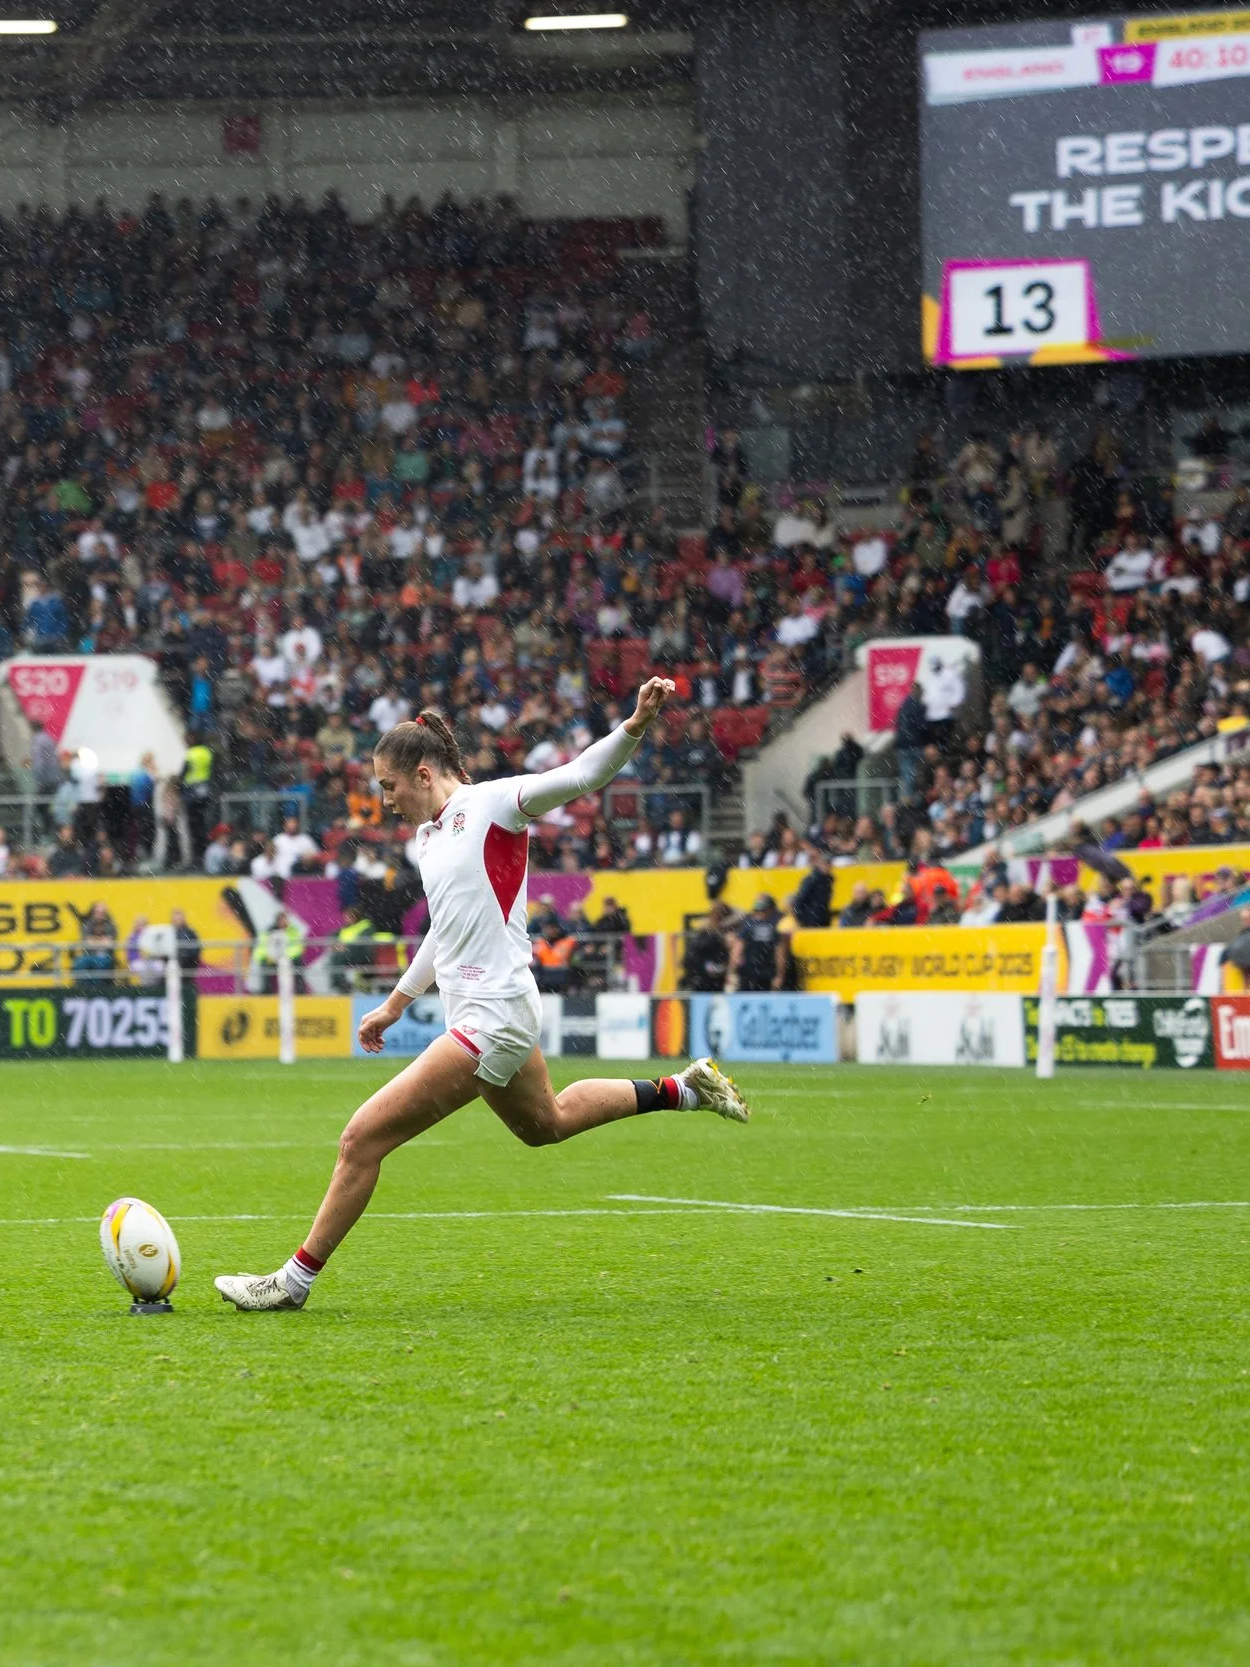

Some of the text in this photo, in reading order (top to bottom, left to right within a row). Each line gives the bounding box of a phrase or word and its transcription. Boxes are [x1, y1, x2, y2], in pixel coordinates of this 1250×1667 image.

[1009, 182, 1143, 233] THE
[982, 280, 1057, 337] 13
[2, 998, 58, 1048] TO
